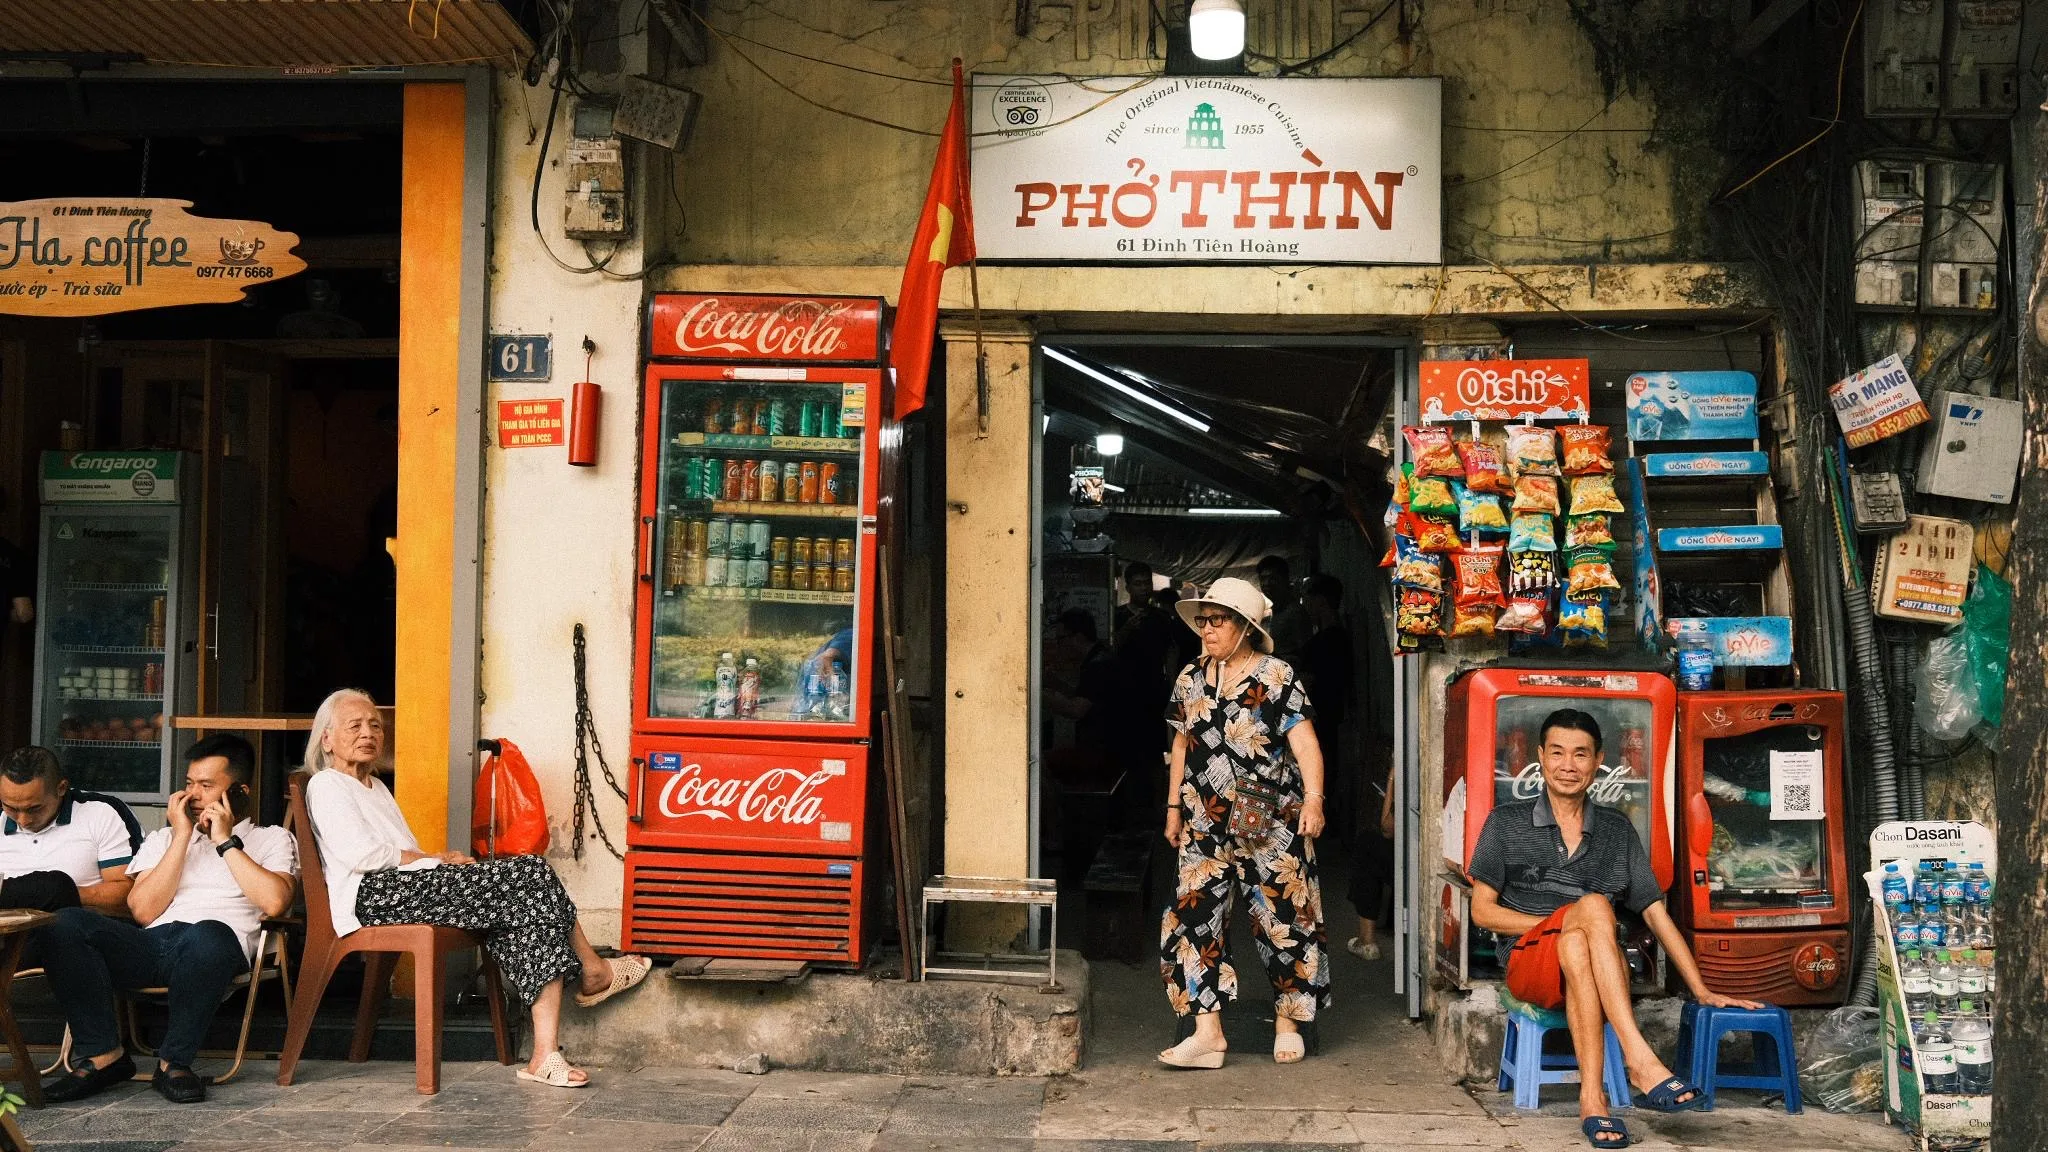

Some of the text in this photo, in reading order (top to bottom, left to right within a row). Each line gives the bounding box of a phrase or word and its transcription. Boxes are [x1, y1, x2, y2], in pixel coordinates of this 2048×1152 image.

[1105, 121, 1127, 147] The
[1125, 80, 1179, 120] Original
[1267, 102, 1304, 149] Cuisine
[1144, 124, 1265, 135] since 1955
[1014, 148, 1405, 231] PHỞ THÌN
[53, 206, 66, 217] 61
[99, 206, 118, 216] Tiên
[119, 206, 152, 218] Hoàng
[81, 218, 192, 286] coffee
[1116, 238, 1136, 252] 61
[1192, 238, 1234, 253] Tiên
[1239, 237, 1300, 256] Hoàng
[196, 267, 273, 278] 0977 47 6668
[28, 282, 47, 299] ép
[63, 281, 90, 296] Trà
[93, 281, 122, 296] sữa
[675, 298, 855, 355] Coca-Cola
[501, 342, 535, 373] 61
[1456, 367, 1549, 406] Oishi
[1860, 369, 1907, 400] MẠNG
[1892, 392, 1903, 400] HD
[523, 405, 533, 415] GIA
[501, 420, 518, 430] THAM
[518, 419, 528, 429] GIA
[551, 419, 561, 428] GIA
[511, 434, 520, 444] AN
[536, 434, 552, 443] PCCC
[64, 453, 158, 473] Kangaroo
[1668, 461, 1692, 470] UỐNG
[1693, 459, 1720, 469] laVie
[1680, 533, 1760, 545] UỐNG laVie NGAY!
[1727, 634, 1771, 653] laVie
[1686, 653, 1712, 661] mentos
[659, 763, 834, 825] Coca-Cola
[1874, 825, 1961, 843] Chọn Dasani
